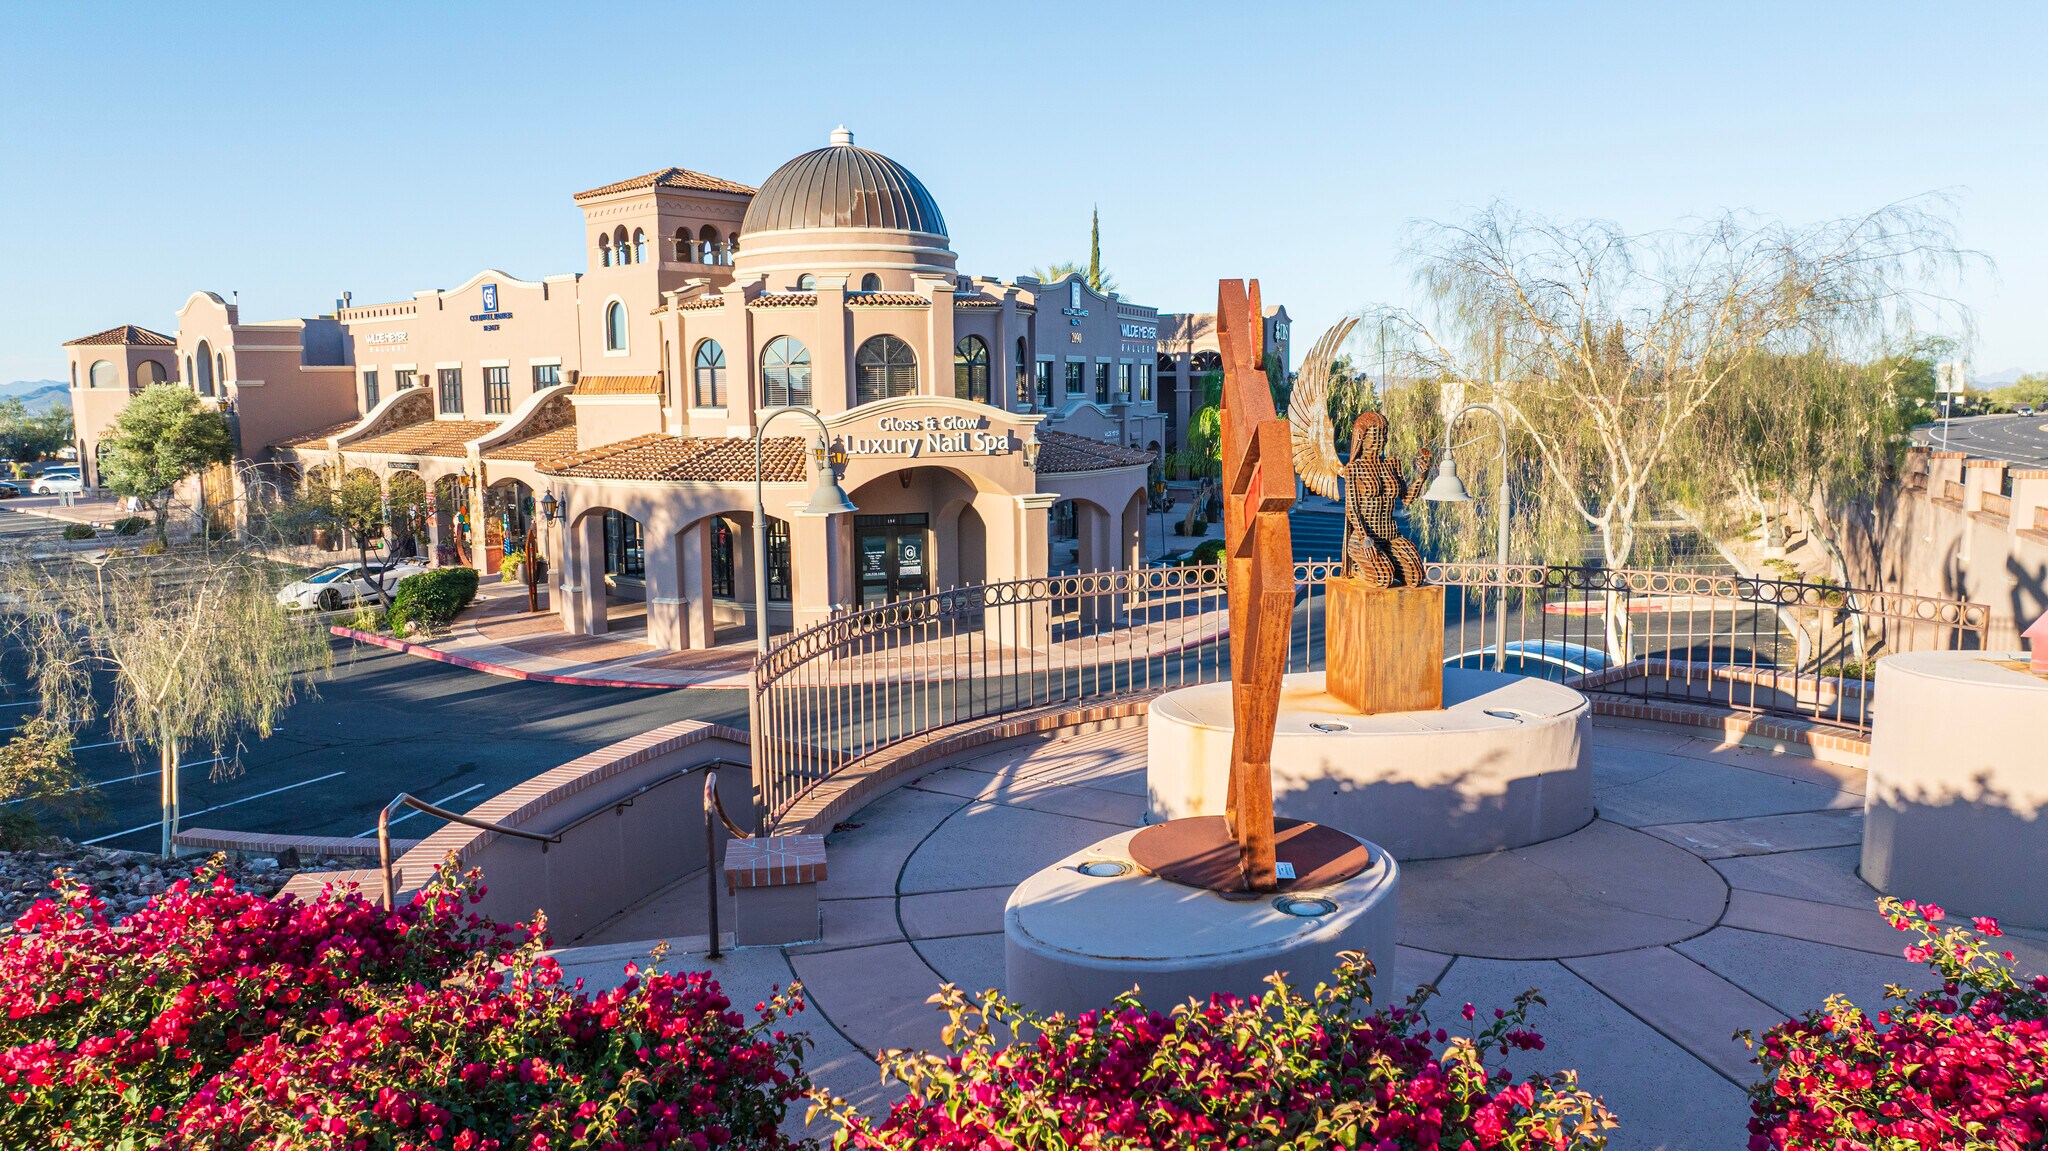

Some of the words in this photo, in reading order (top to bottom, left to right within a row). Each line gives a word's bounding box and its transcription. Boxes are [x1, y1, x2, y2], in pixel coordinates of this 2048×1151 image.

[878, 416, 919, 431] Gloss
[924, 416, 936, 430] &
[941, 415, 980, 430] Glow
[844, 435, 920, 458] Luxury
[926, 433, 966, 452] Nail
[974, 431, 1009, 455] Spa
